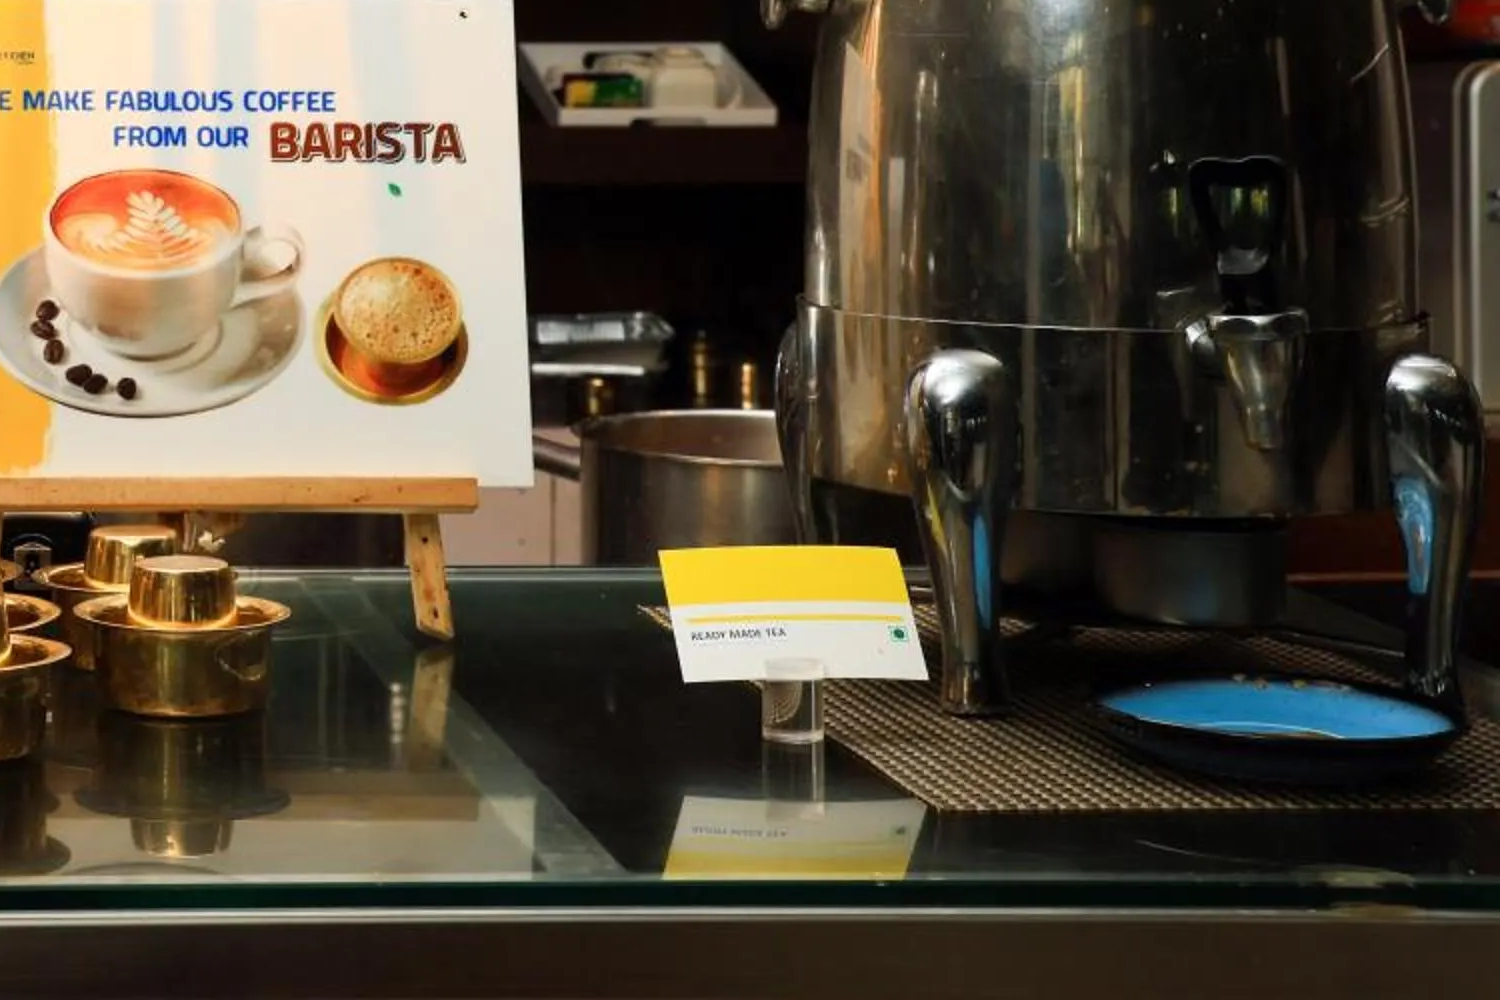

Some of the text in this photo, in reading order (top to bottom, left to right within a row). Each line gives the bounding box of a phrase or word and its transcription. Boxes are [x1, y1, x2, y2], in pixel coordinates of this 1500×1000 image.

[22, 90, 96, 111] MAKE
[105, 90, 234, 112] FABULOUS
[243, 90, 337, 112] COFFEE
[113, 121, 467, 164] FROM OUR BARISTA
[690, 631, 726, 641] READY
[765, 627, 788, 637] TEA
